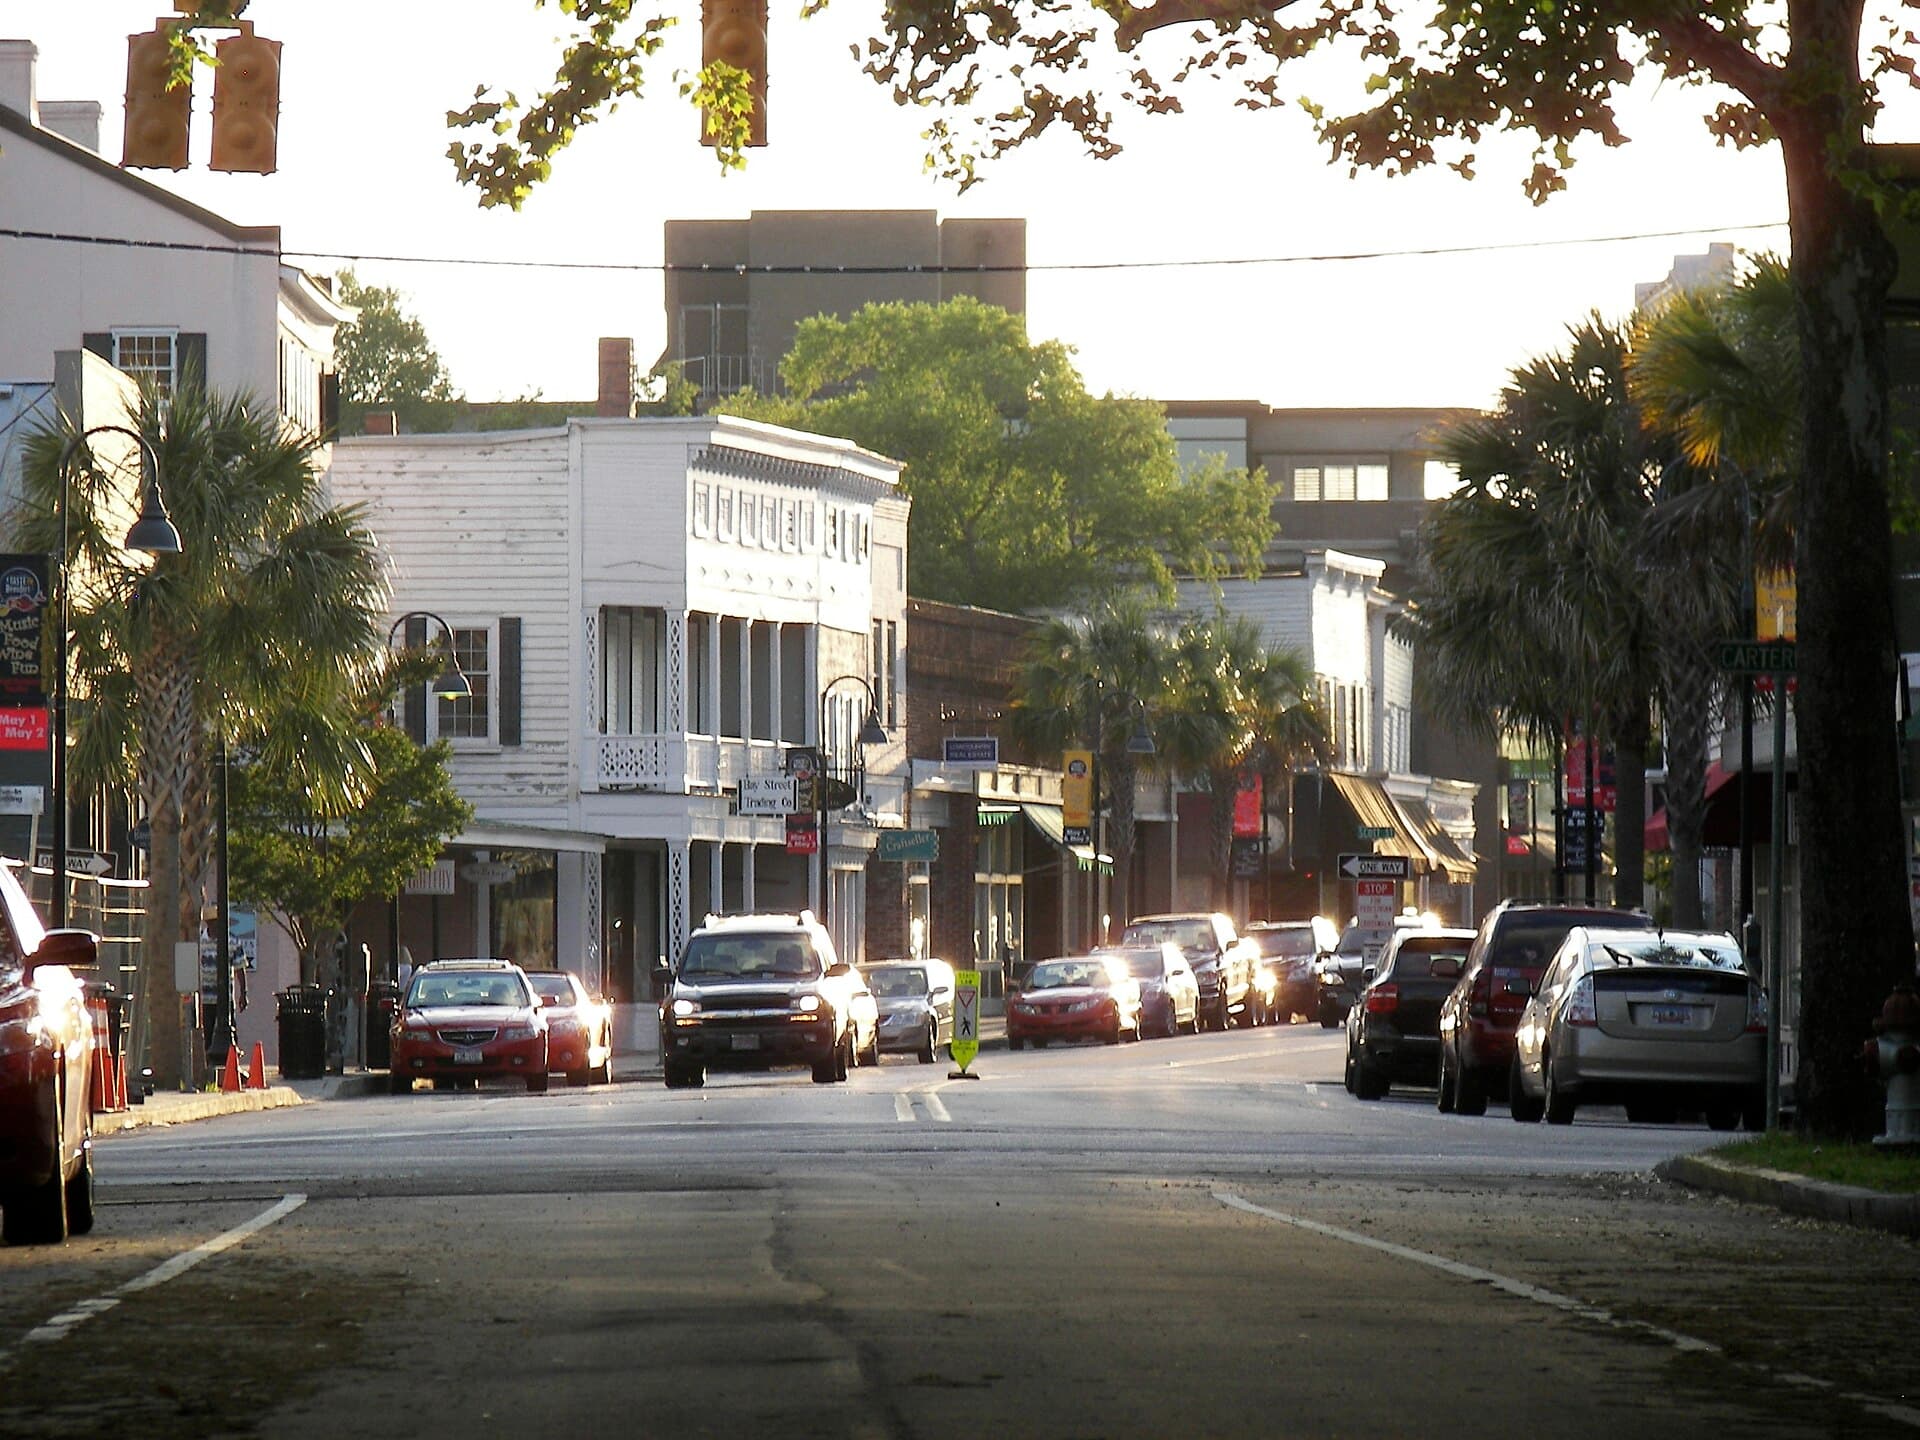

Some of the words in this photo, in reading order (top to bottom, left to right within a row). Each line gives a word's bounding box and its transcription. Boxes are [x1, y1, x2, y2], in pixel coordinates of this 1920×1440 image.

[0, 616, 39, 632] Music
[4, 633, 40, 650] Food
[1722, 647, 1797, 669] CARTER
[11, 661, 39, 674] Fun
[0, 715, 25, 727] May
[5, 727, 32, 739] May
[37, 727, 44, 737] 2
[743, 779, 759, 792] Bay
[764, 779, 791, 790] Street
[744, 797, 776, 809] Trading
[67, 858, 90, 870] WAY
[1360, 863, 1377, 872] ONE
[1381, 863, 1401, 872] WAY
[1364, 884, 1388, 894] STOP
